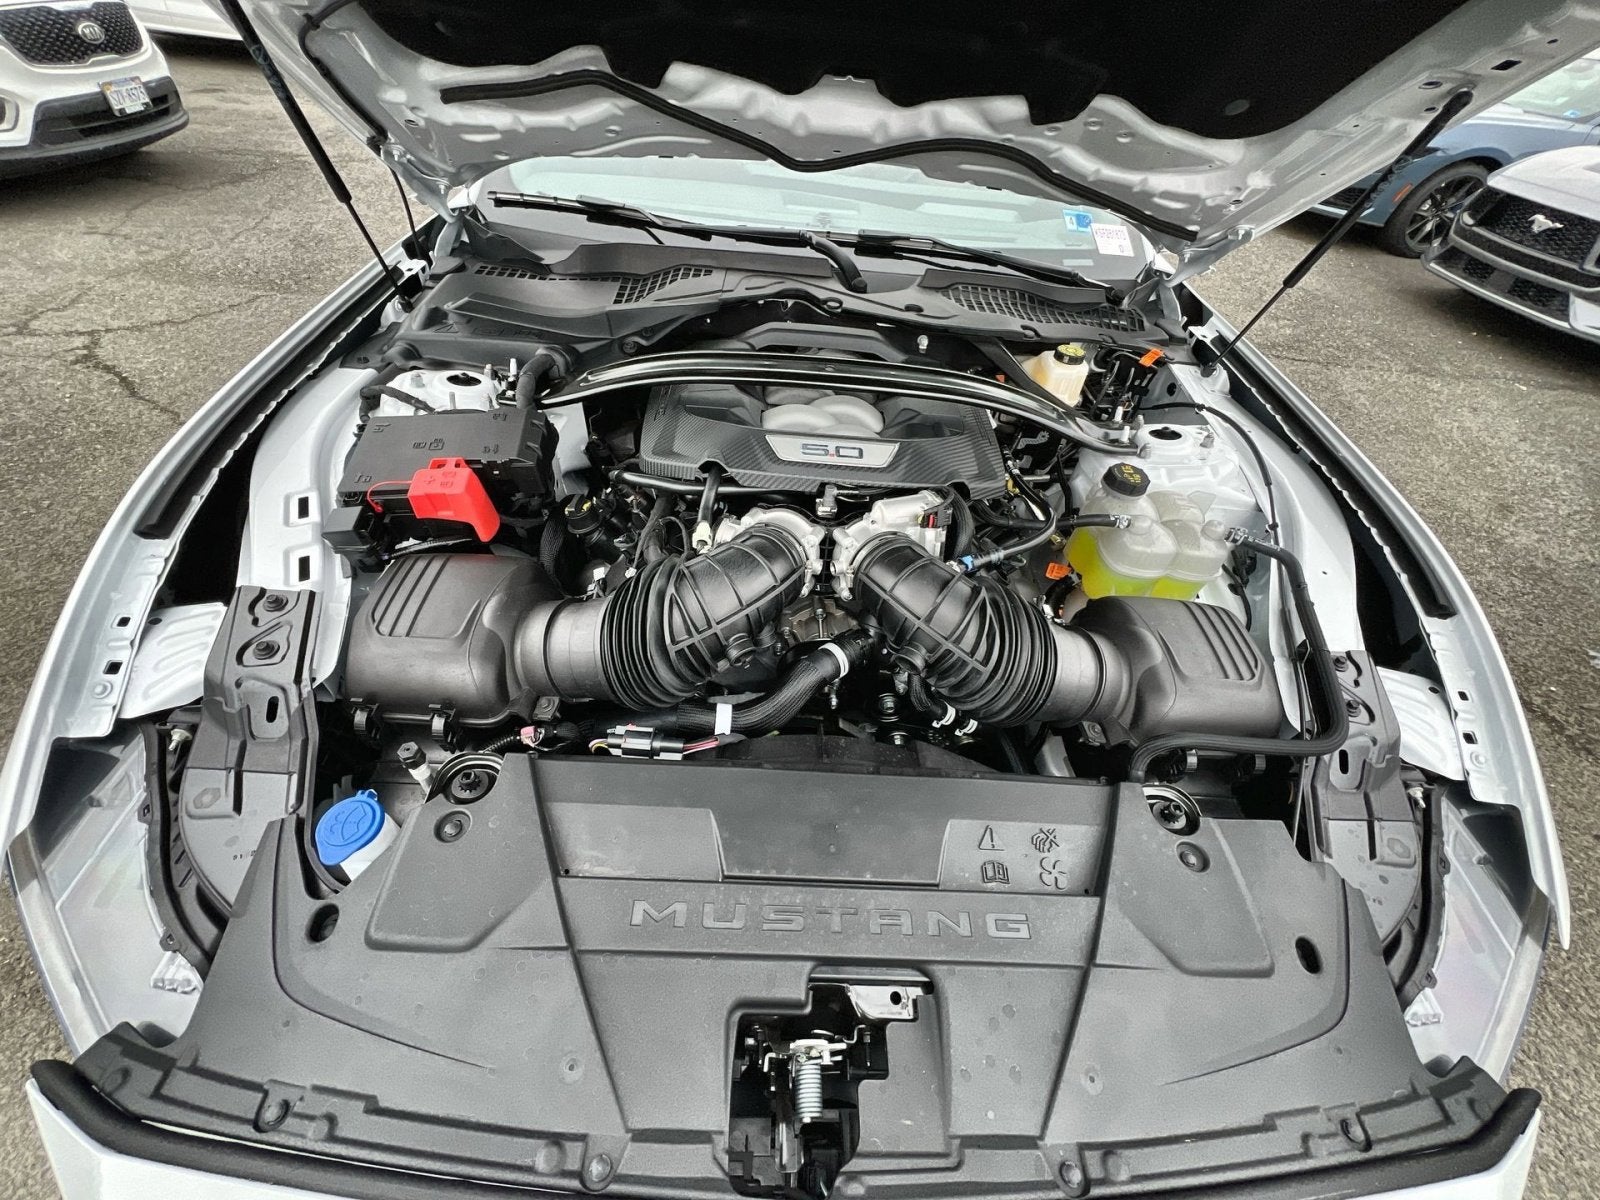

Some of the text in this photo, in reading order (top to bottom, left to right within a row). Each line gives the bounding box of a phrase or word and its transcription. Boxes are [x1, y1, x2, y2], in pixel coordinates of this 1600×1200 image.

[82, 26, 103, 39] KIA
[801, 443, 864, 460] 5.0
[629, 900, 1032, 940] MUSTANG
